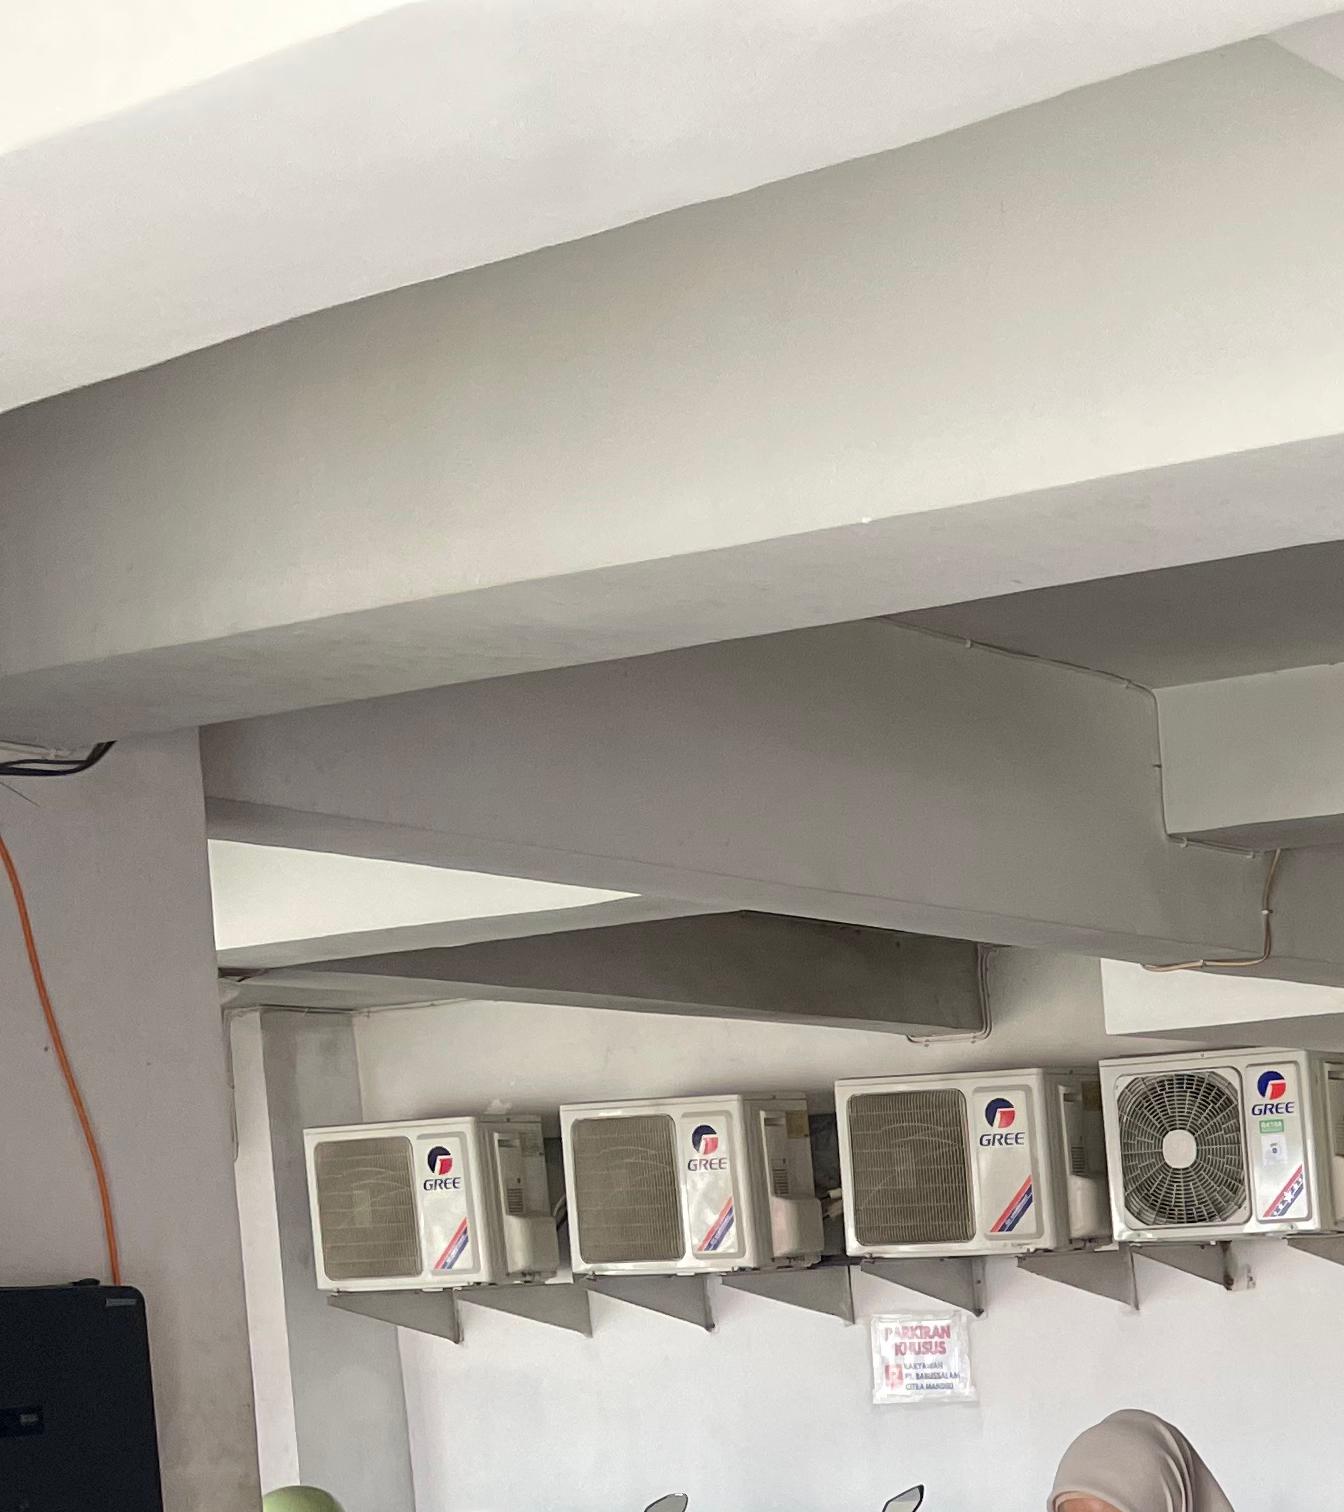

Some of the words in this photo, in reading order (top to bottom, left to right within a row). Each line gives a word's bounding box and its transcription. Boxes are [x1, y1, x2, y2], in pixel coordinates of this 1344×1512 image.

[1251, 1101, 1295, 1116] GREE
[979, 1132, 1025, 1146] GREE
[688, 1157, 728, 1171] GREE
[423, 1177, 461, 1191] GREE
[884, 1325, 951, 1341] PARKIRAN
[894, 1341, 947, 1356] KHUSUS
